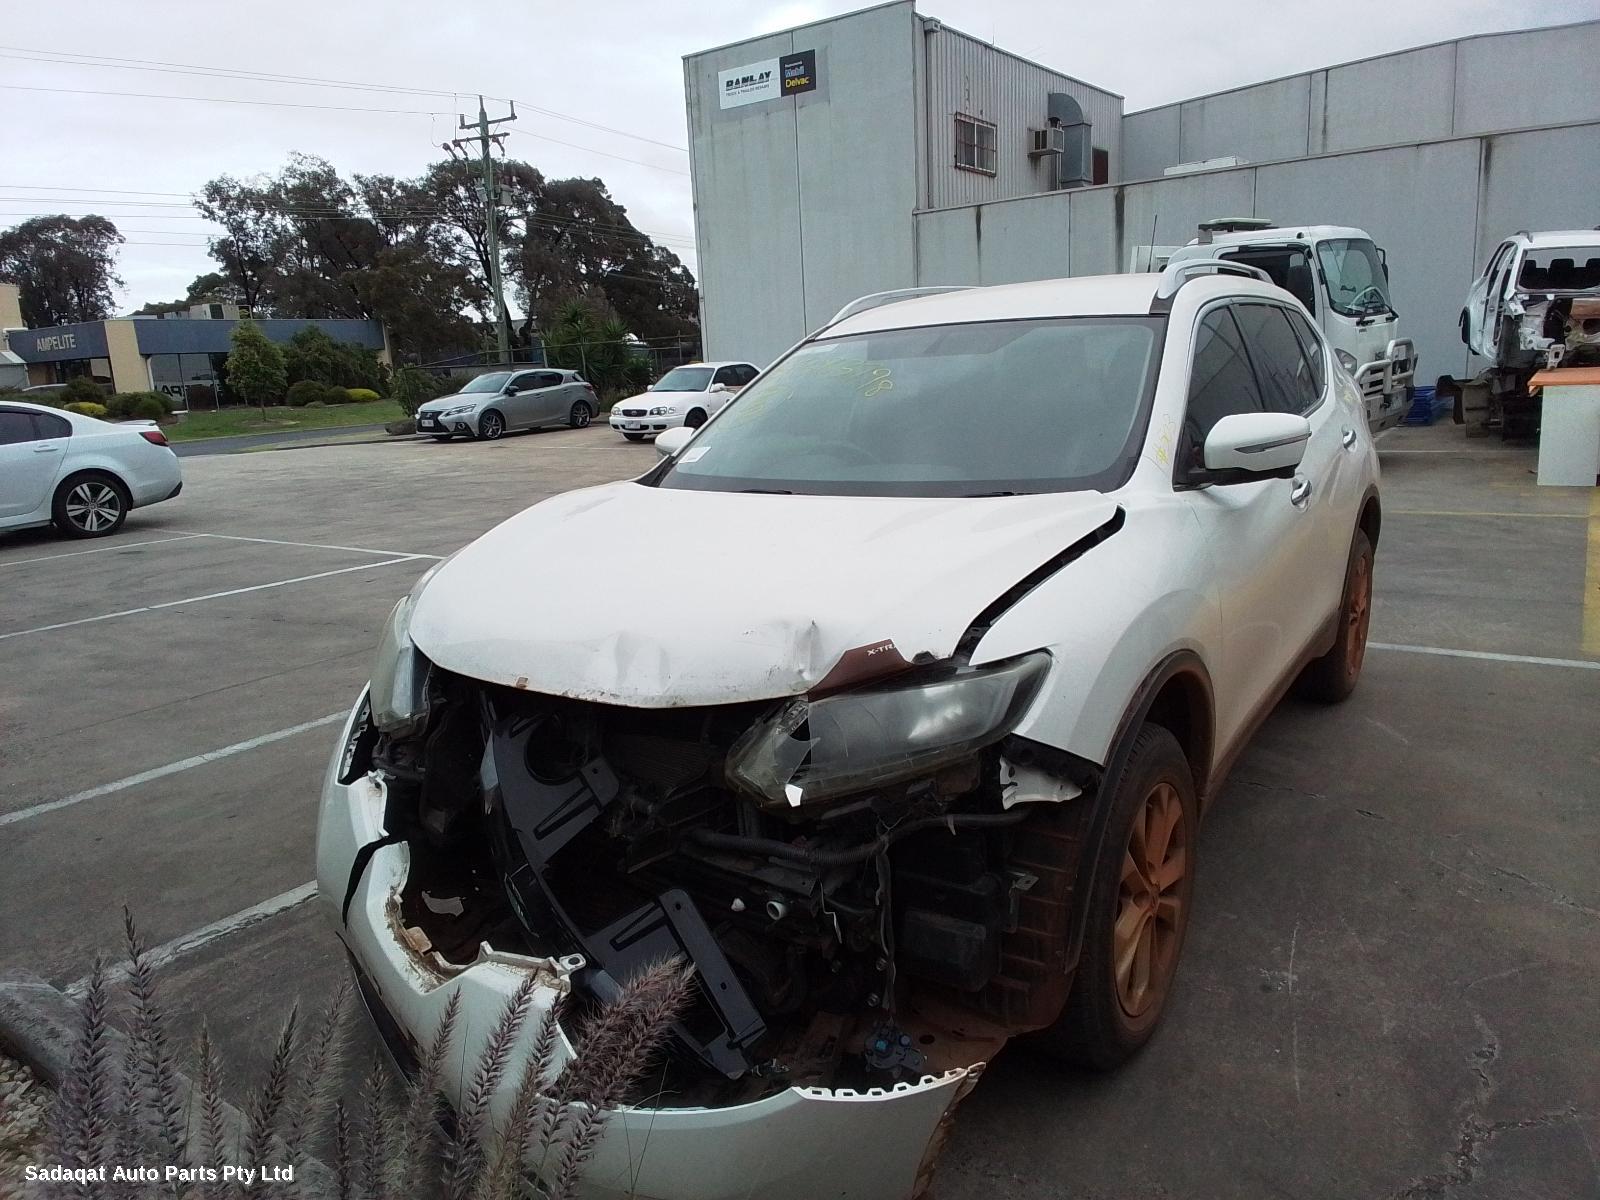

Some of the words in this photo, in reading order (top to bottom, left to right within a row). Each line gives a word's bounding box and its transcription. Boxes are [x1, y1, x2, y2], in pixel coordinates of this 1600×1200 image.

[785, 76, 810, 88] Delvac
[36, 333, 77, 352] AMPELITE
[867, 643, 896, 657] X-TR
